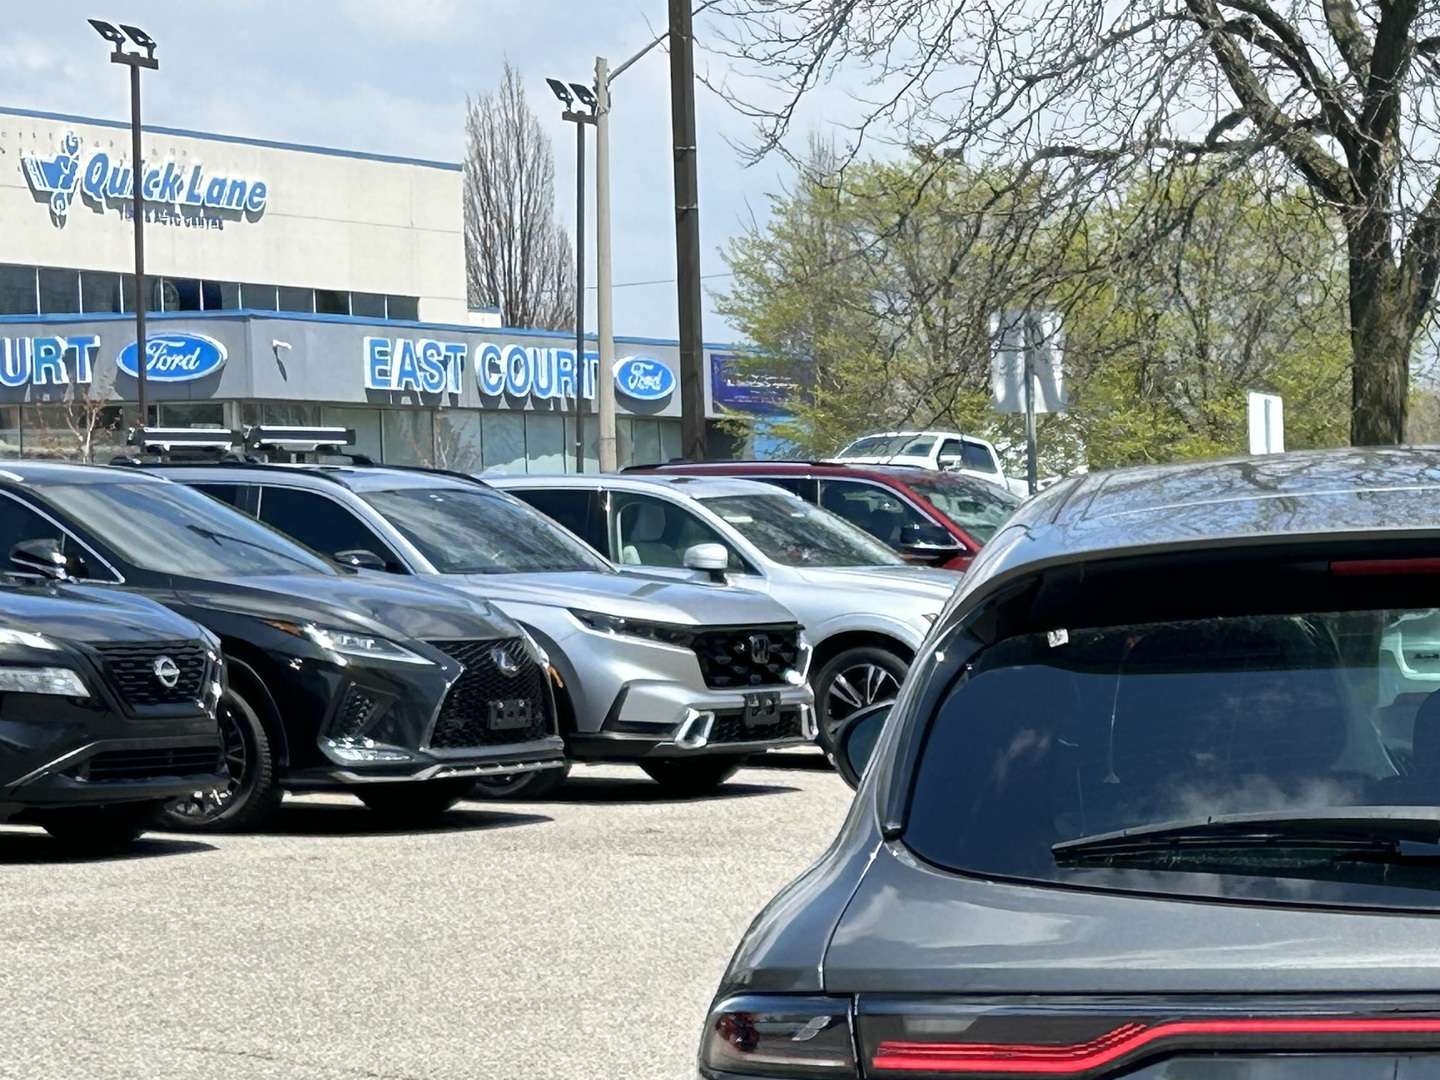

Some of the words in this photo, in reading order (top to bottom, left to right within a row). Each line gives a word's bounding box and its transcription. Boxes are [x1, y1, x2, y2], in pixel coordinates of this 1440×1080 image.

[184, 164, 268, 212] Lane
[145, 339, 201, 371] Ford
[364, 336, 467, 396] EAST
[627, 361, 664, 391] Ford
